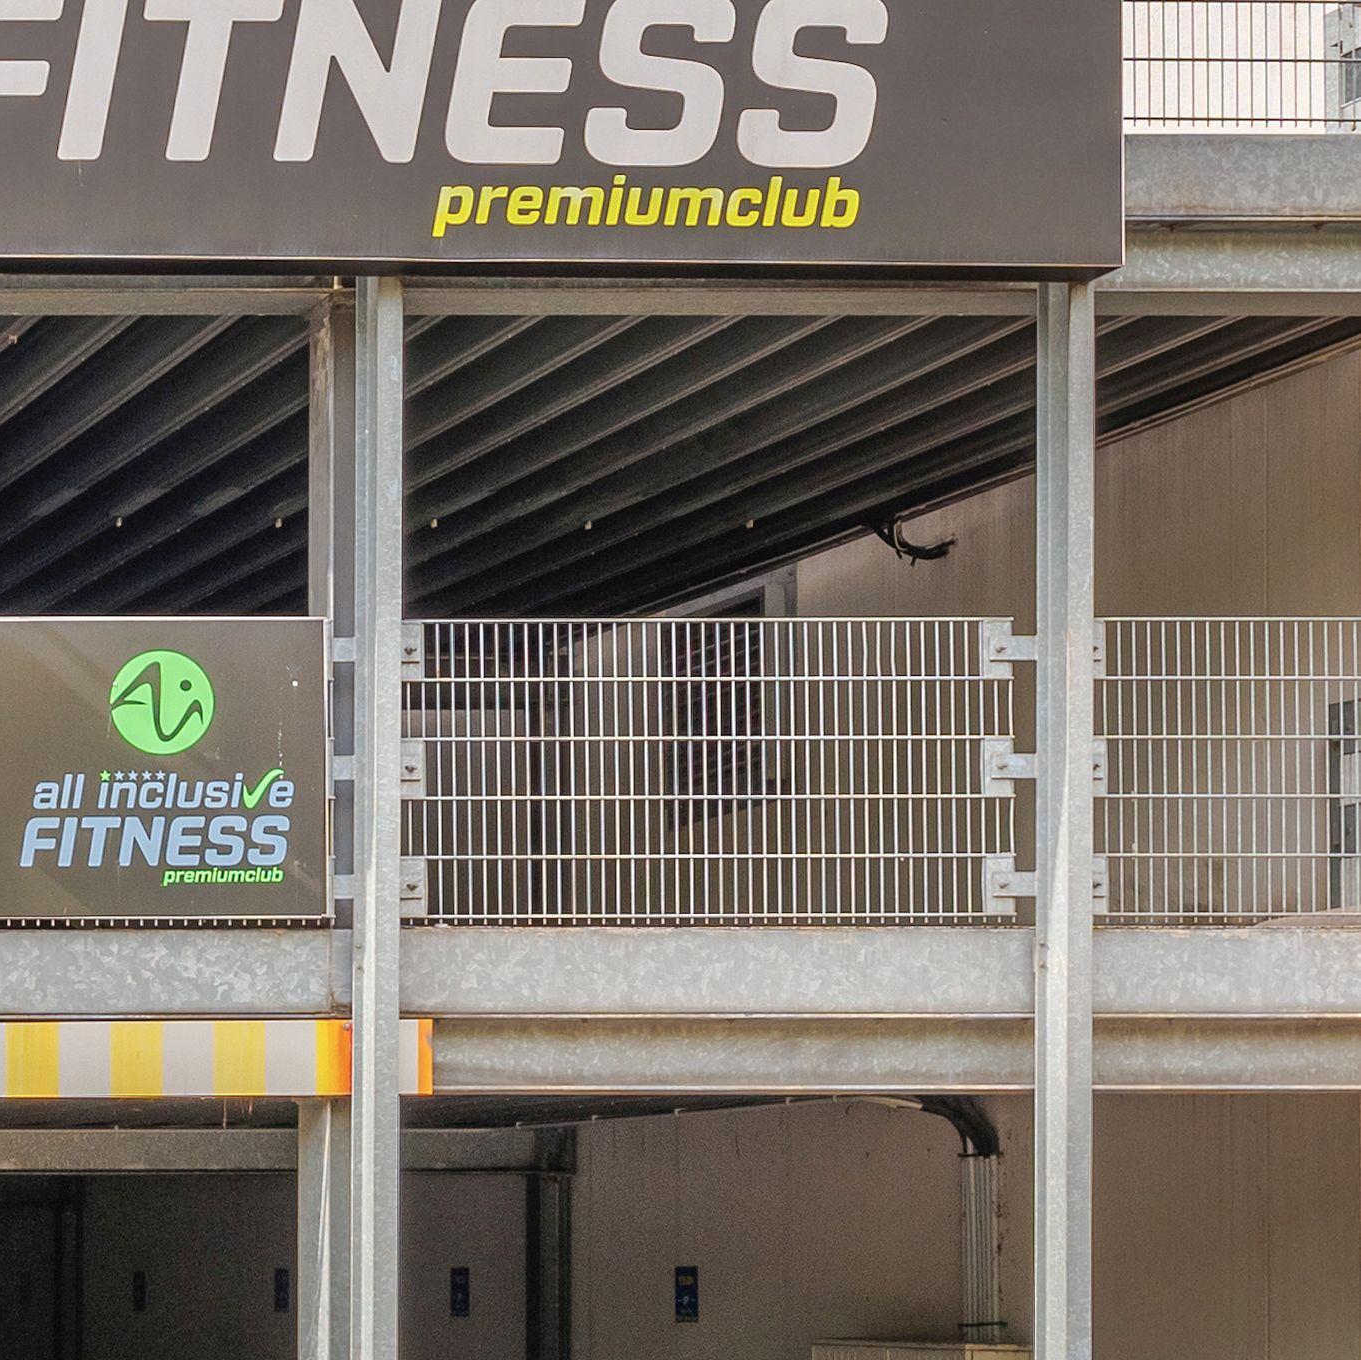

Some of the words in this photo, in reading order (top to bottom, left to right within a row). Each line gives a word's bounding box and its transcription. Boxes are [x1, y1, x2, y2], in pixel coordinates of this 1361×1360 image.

[431, 173, 861, 237] premiumclub
[33, 774, 85, 810] all
[98, 769, 295, 810] inclusive
[20, 816, 291, 868] FITNESS
[162, 868, 285, 887] premiumclub
